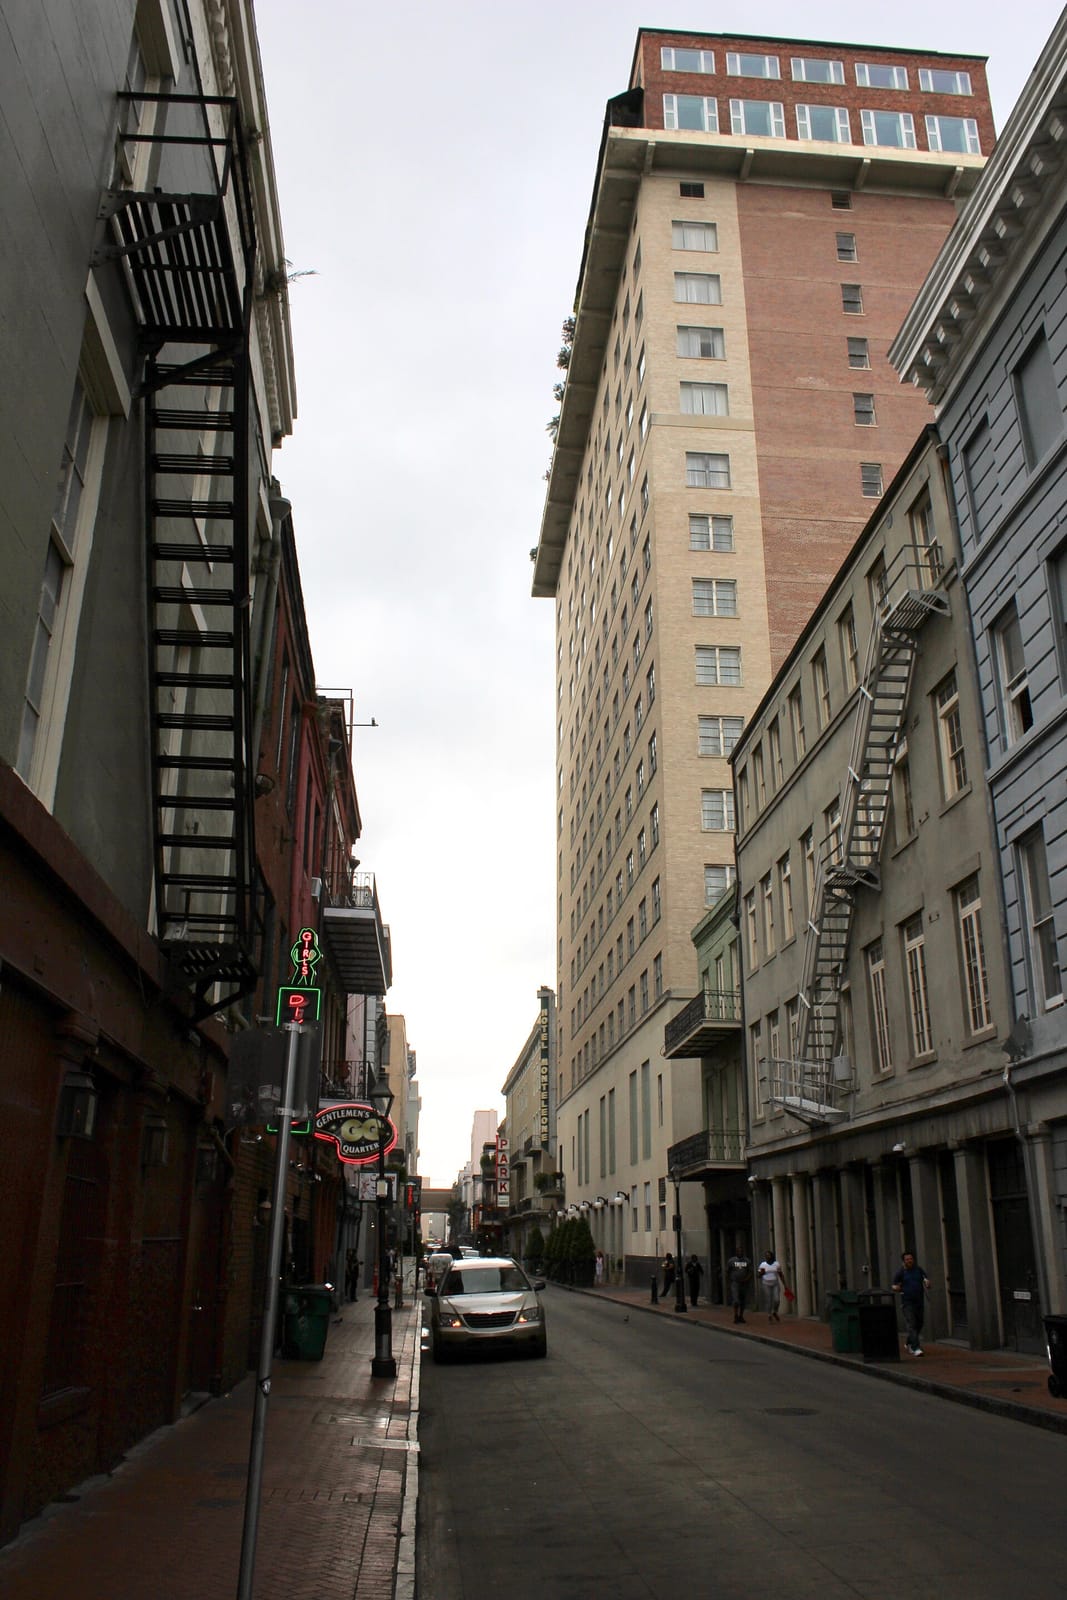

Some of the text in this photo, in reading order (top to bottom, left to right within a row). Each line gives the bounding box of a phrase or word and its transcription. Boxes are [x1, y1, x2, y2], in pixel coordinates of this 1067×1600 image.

[302, 931, 312, 976] GIRLS
[316, 1109, 371, 1128] GENTLEMEN'S
[342, 1142, 380, 1154] QUARTER
[500, 1139, 508, 1192] PARK
